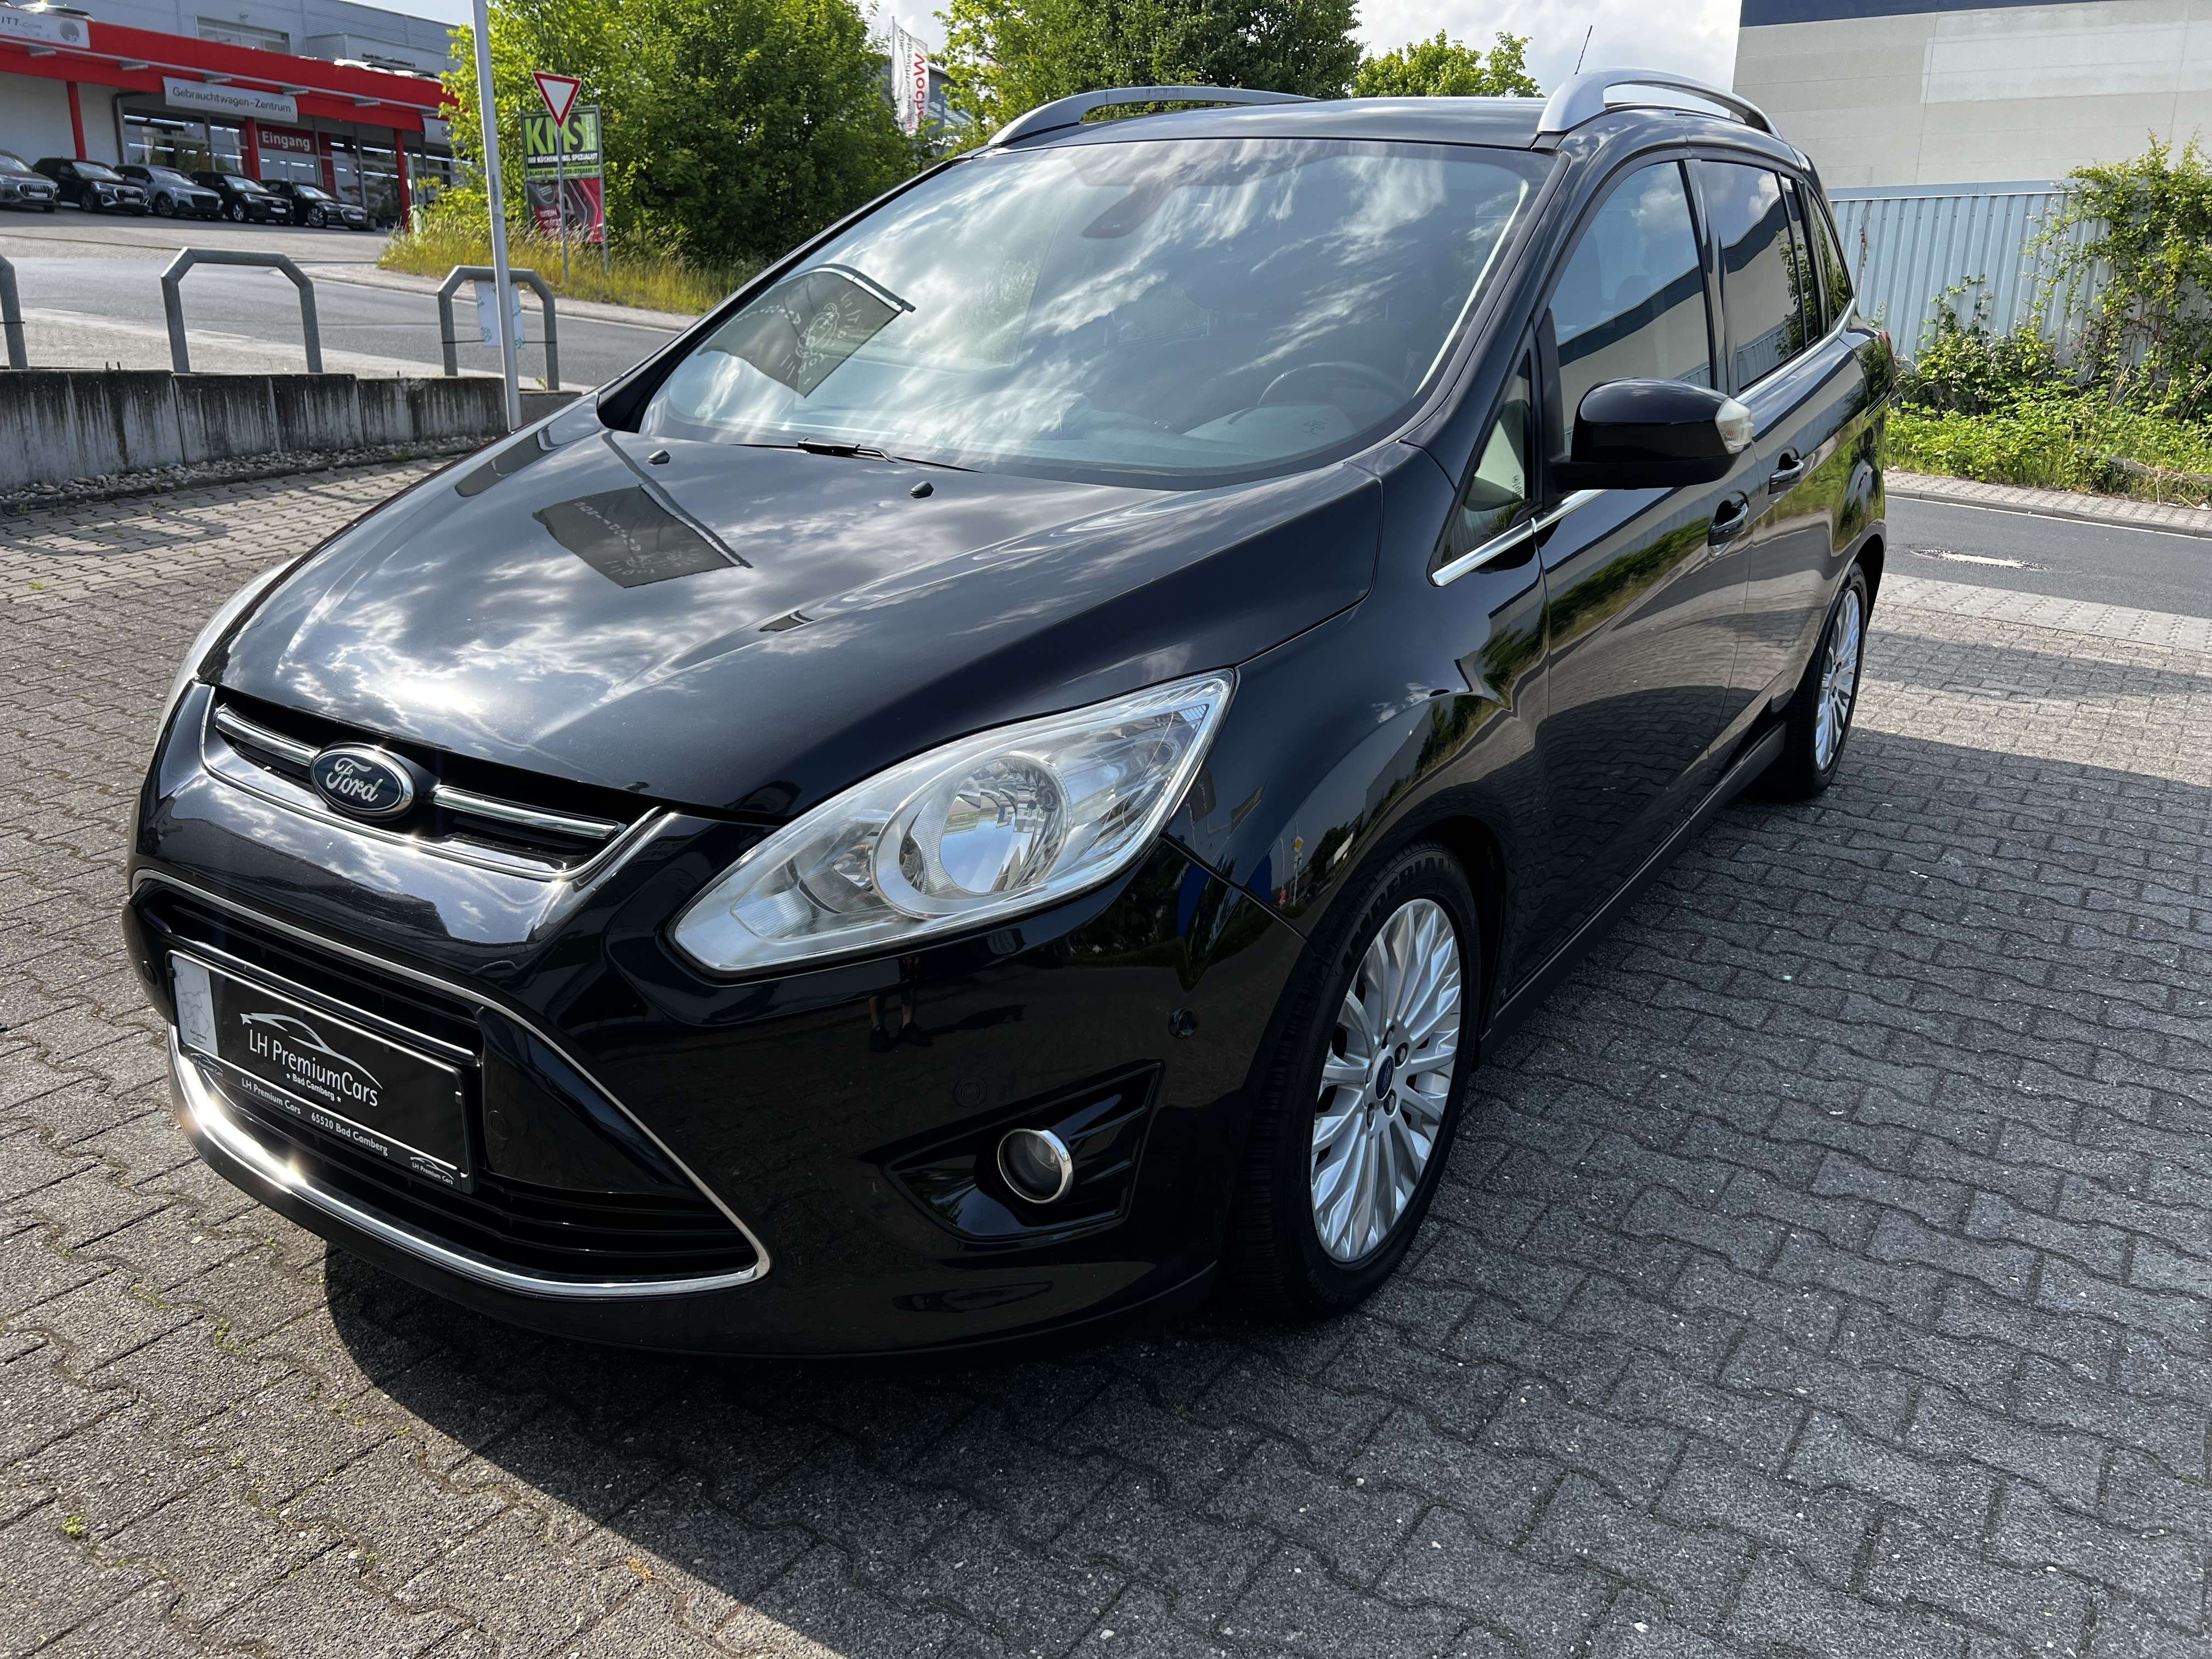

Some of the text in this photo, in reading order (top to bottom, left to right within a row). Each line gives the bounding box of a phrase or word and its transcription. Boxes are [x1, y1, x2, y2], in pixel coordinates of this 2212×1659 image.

[172, 86, 291, 113] Gebrauchtwagen-Zentrum
[262, 131, 311, 152] Eingang
[326, 757, 383, 802] Ford
[249, 1029, 379, 1107] LH PremiumCars
[292, 1073, 336, 1101] Bad Camberg
[241, 1077, 389, 1156] LH Premium Cars 65520 Bad Camberg
[412, 1161, 454, 1185] LH Premium Cars
